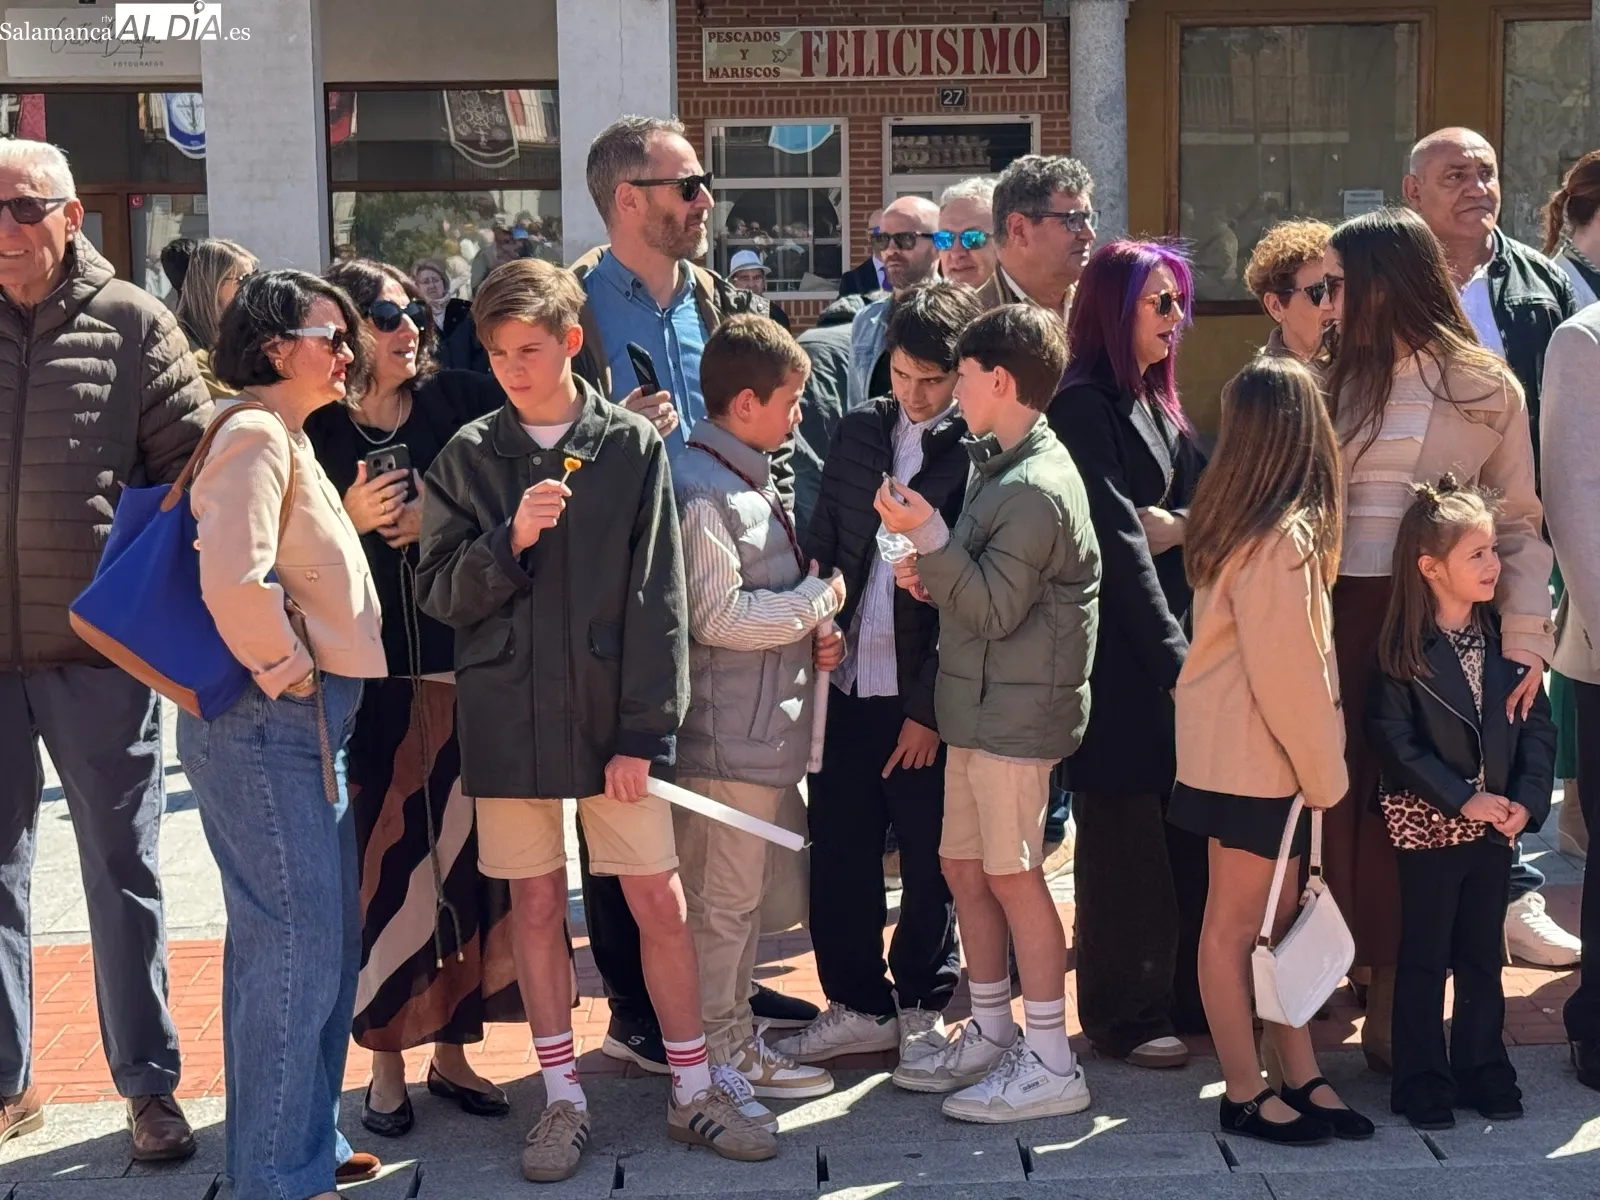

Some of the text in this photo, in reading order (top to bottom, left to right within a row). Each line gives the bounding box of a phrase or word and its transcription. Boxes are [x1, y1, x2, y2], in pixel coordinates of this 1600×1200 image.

[708, 31, 781, 43] PESCADOS
[739, 48, 750, 60] Y
[800, 26, 1041, 78] FELICISIMO
[708, 67, 781, 79] MARISCOS
[942, 89, 964, 106] 27
